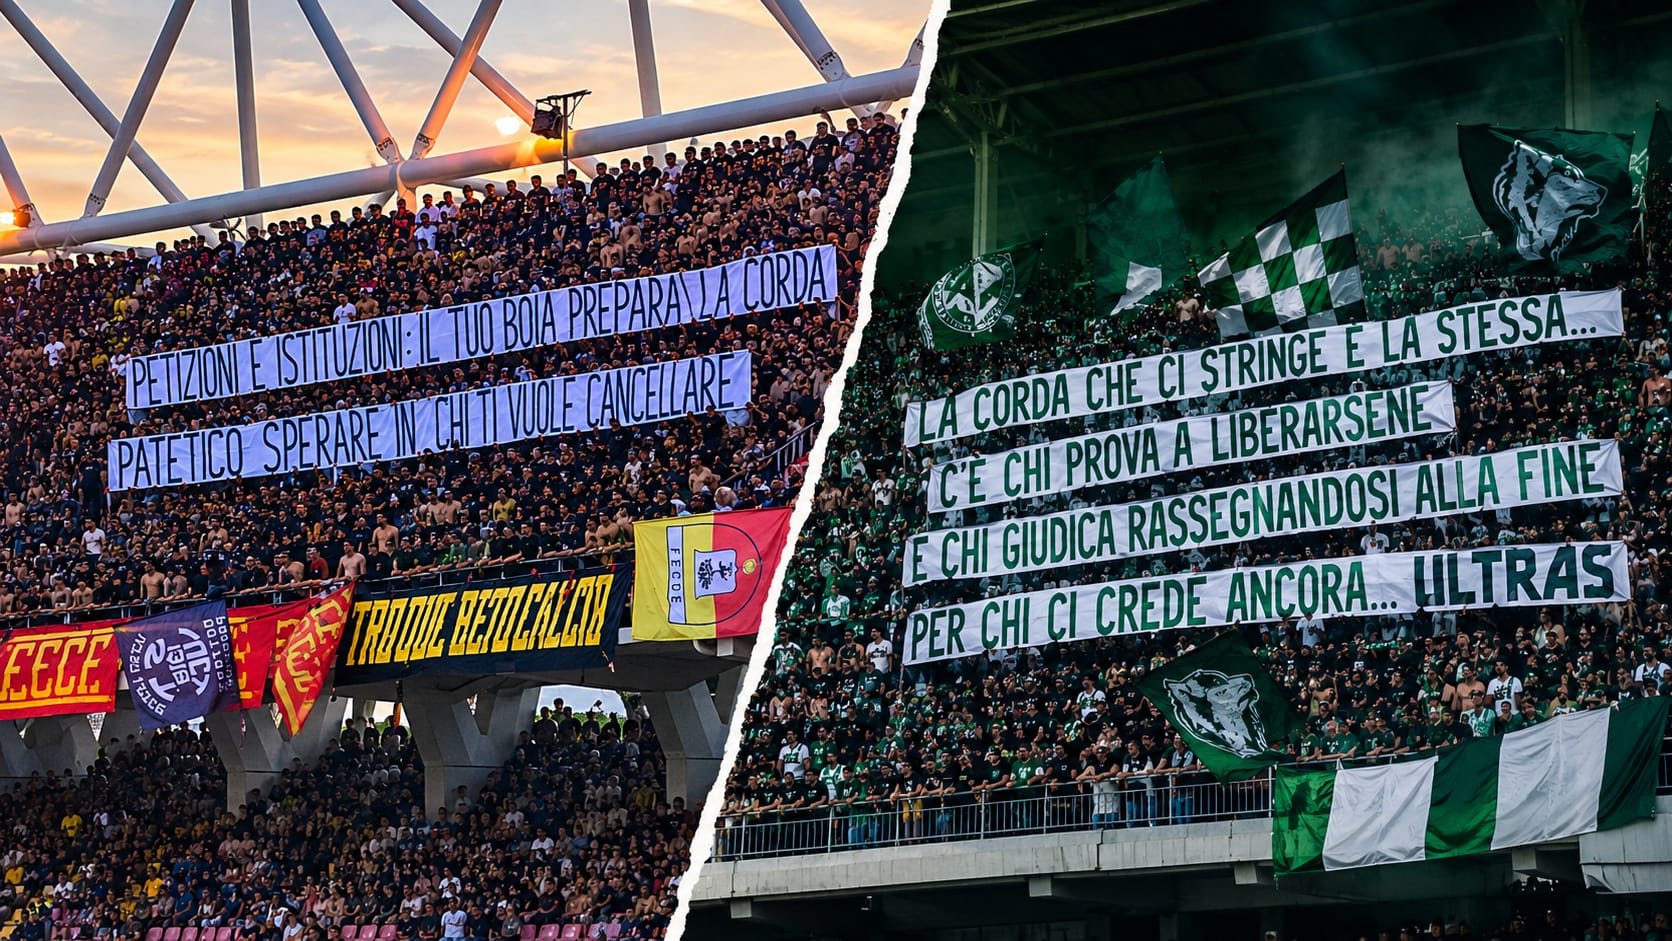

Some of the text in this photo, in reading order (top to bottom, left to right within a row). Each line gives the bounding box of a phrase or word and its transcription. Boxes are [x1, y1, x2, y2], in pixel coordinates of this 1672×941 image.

[132, 343, 239, 407] PETIZIONI
[250, 338, 266, 391] E
[419, 311, 440, 365] IL
[447, 302, 494, 360] TUO
[504, 293, 557, 351] BOIA
[699, 264, 731, 320] LA
[743, 248, 827, 310] CORDA
[919, 393, 959, 442] LA
[973, 373, 1071, 431] CORDA
[1086, 360, 1143, 411] CHE
[1158, 353, 1186, 399] CI
[1200, 330, 1328, 393] STRINGE
[1382, 316, 1422, 363] LA
[1436, 294, 1598, 355] STESSA...
[119, 353, 736, 489] PATETICO SPERARE IN CHI TI VUOLE CANCELLARE
[1004, 447, 1051, 498] CHI
[1066, 426, 1161, 488] PROVA
[1173, 421, 1194, 469] A
[1211, 384, 1432, 462] LIBERARSENE
[912, 442, 1604, 582] E CHI GIUDICA RASSEGNANDOSI ALLA FINE
[912, 544, 1615, 661] PER CHI CI CREDE ANCORA... ULTRAS
